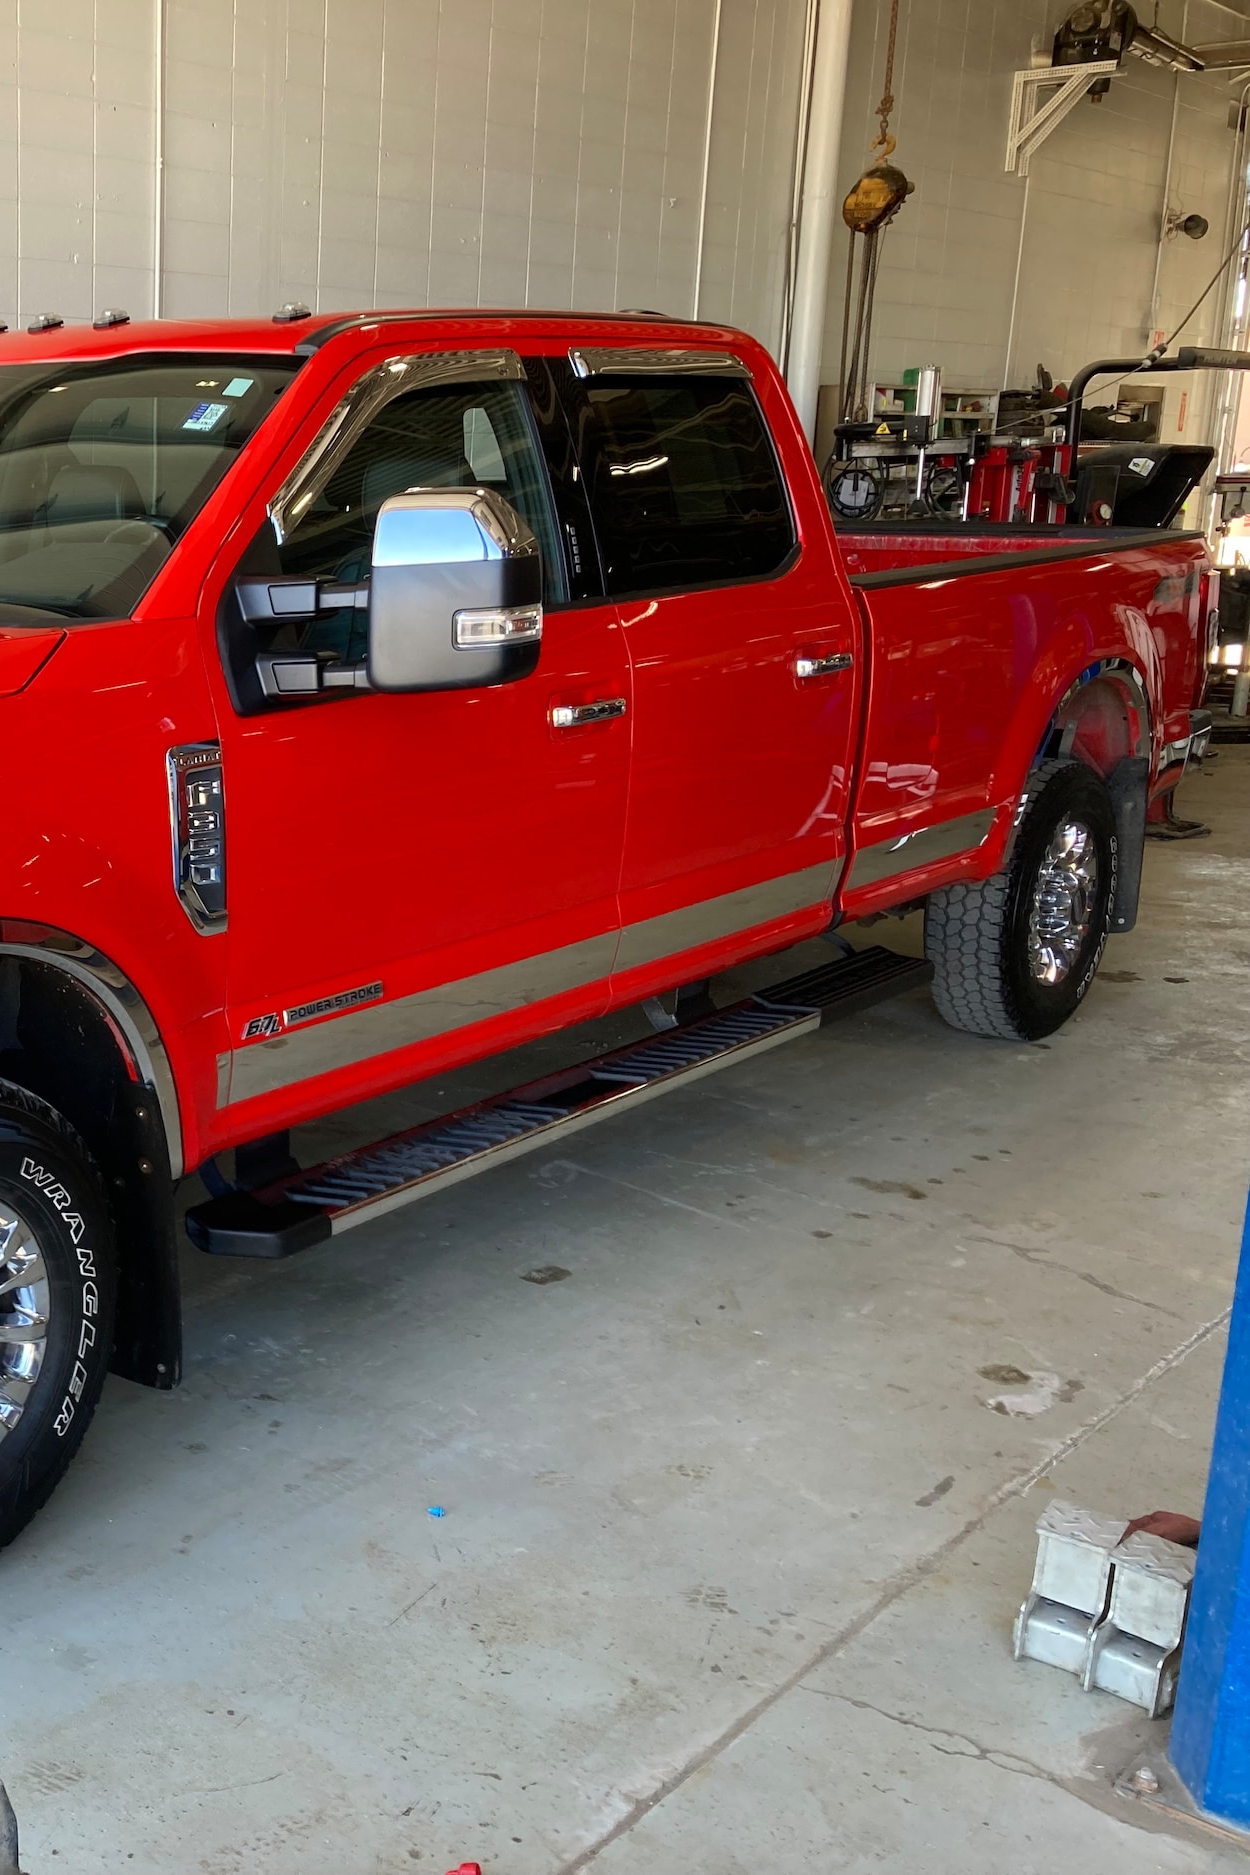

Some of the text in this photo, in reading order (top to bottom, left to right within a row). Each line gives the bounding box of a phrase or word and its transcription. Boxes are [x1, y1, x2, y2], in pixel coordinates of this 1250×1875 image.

[289, 999, 332, 1020] POWER
[334, 983, 382, 1007] STROKE
[20, 1157, 98, 1436] WRANGLER
